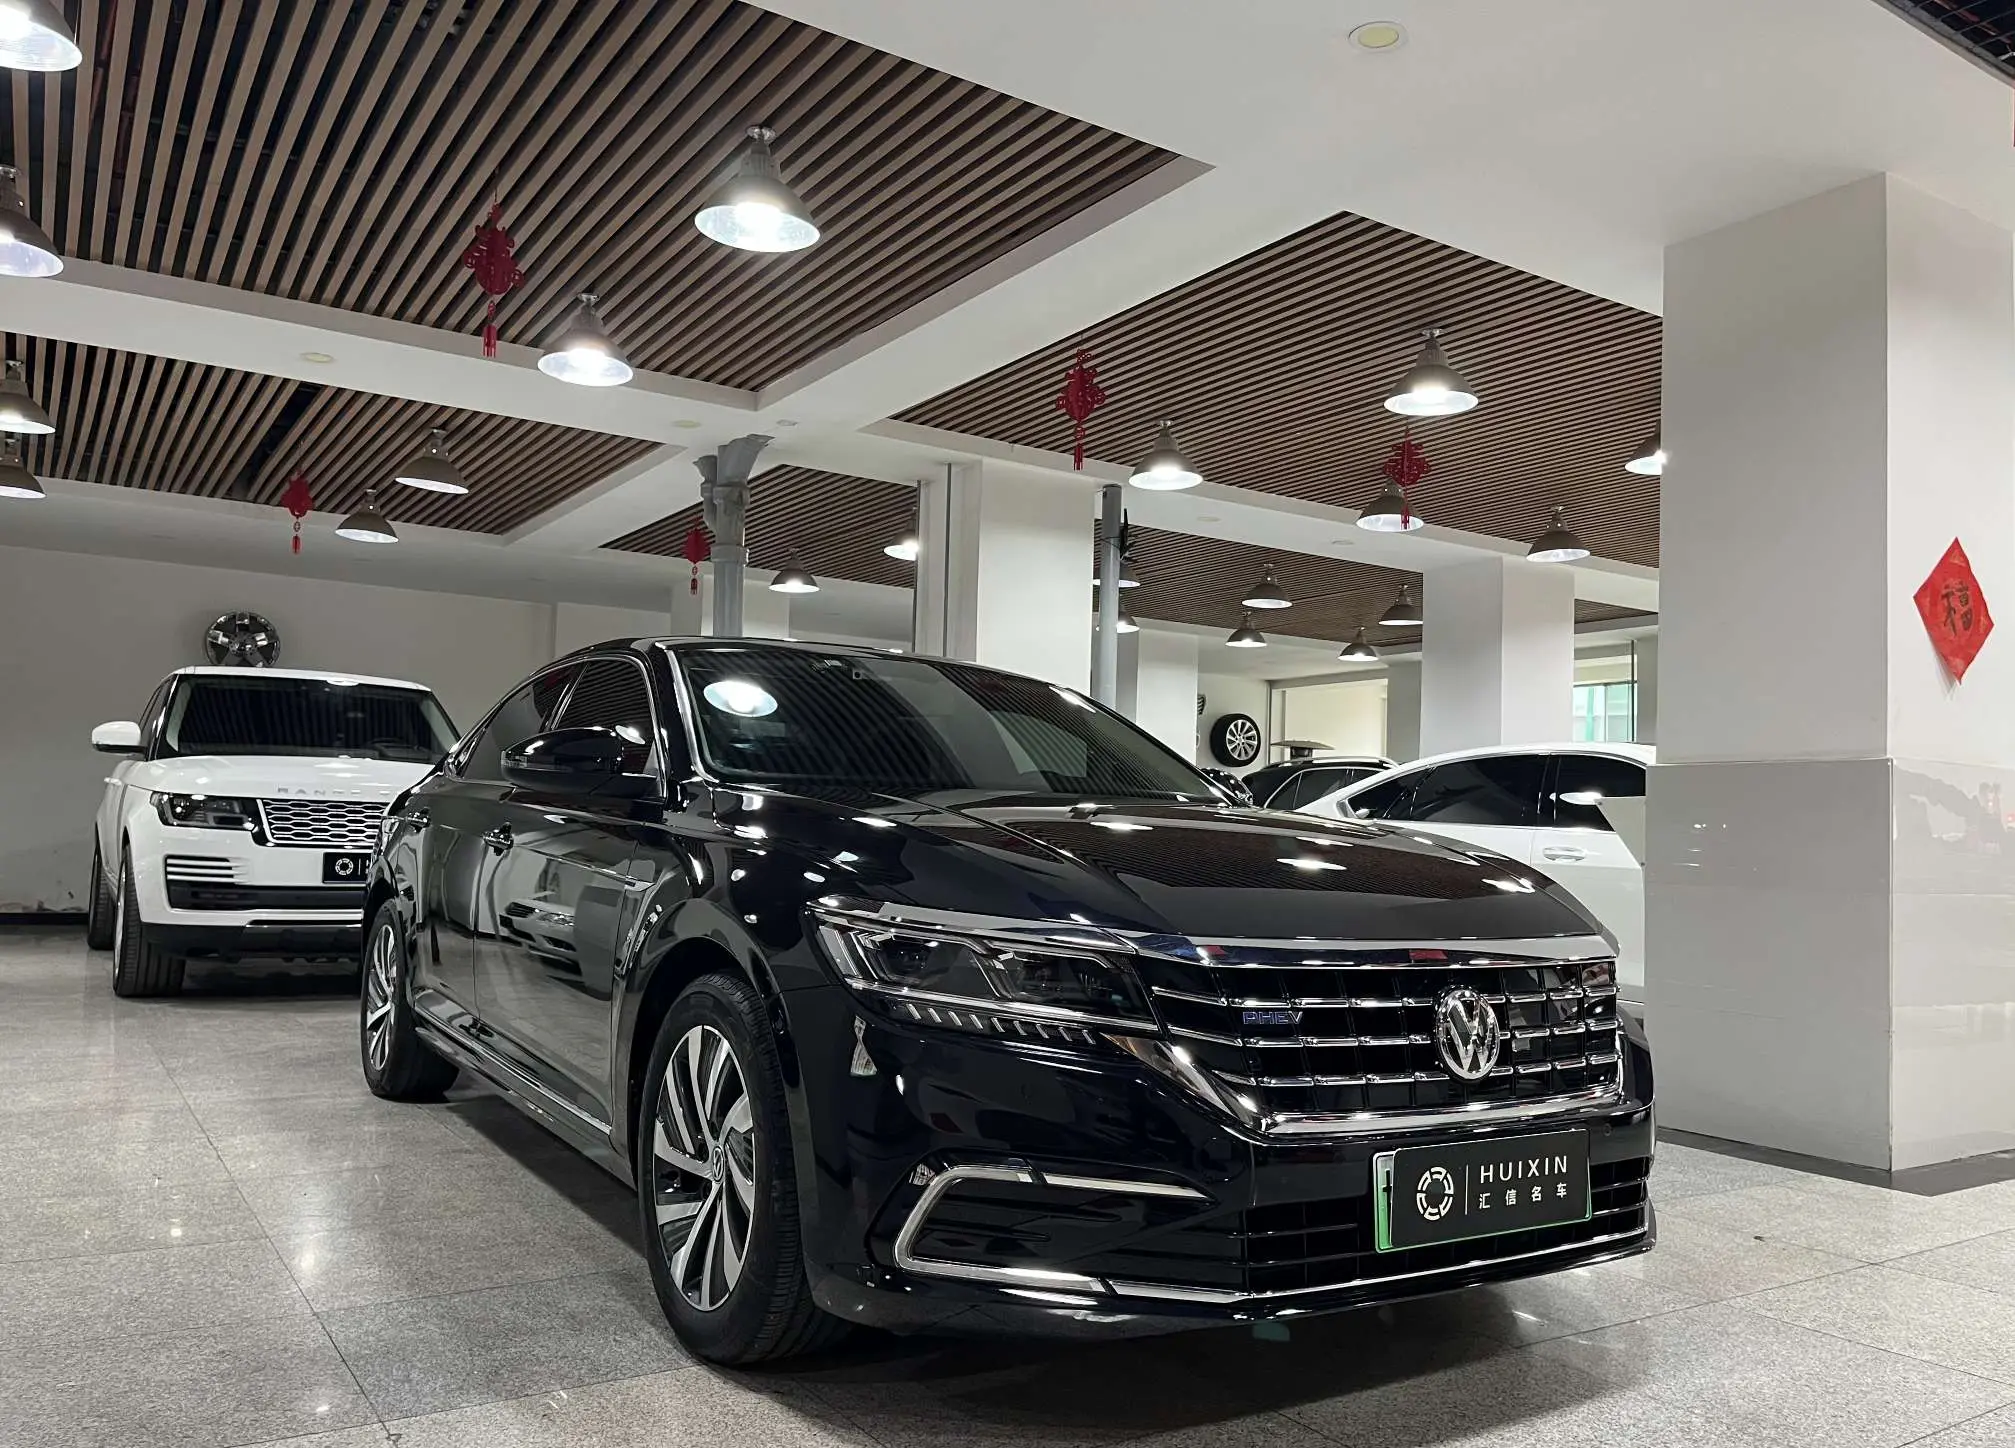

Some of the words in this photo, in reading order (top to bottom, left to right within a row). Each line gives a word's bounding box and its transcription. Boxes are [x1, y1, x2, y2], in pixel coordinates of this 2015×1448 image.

[1242, 1010, 1303, 1025] PHEV
[1479, 1155, 1568, 1184] HUIXIN
[1478, 1181, 1568, 1210] 汇信名车
